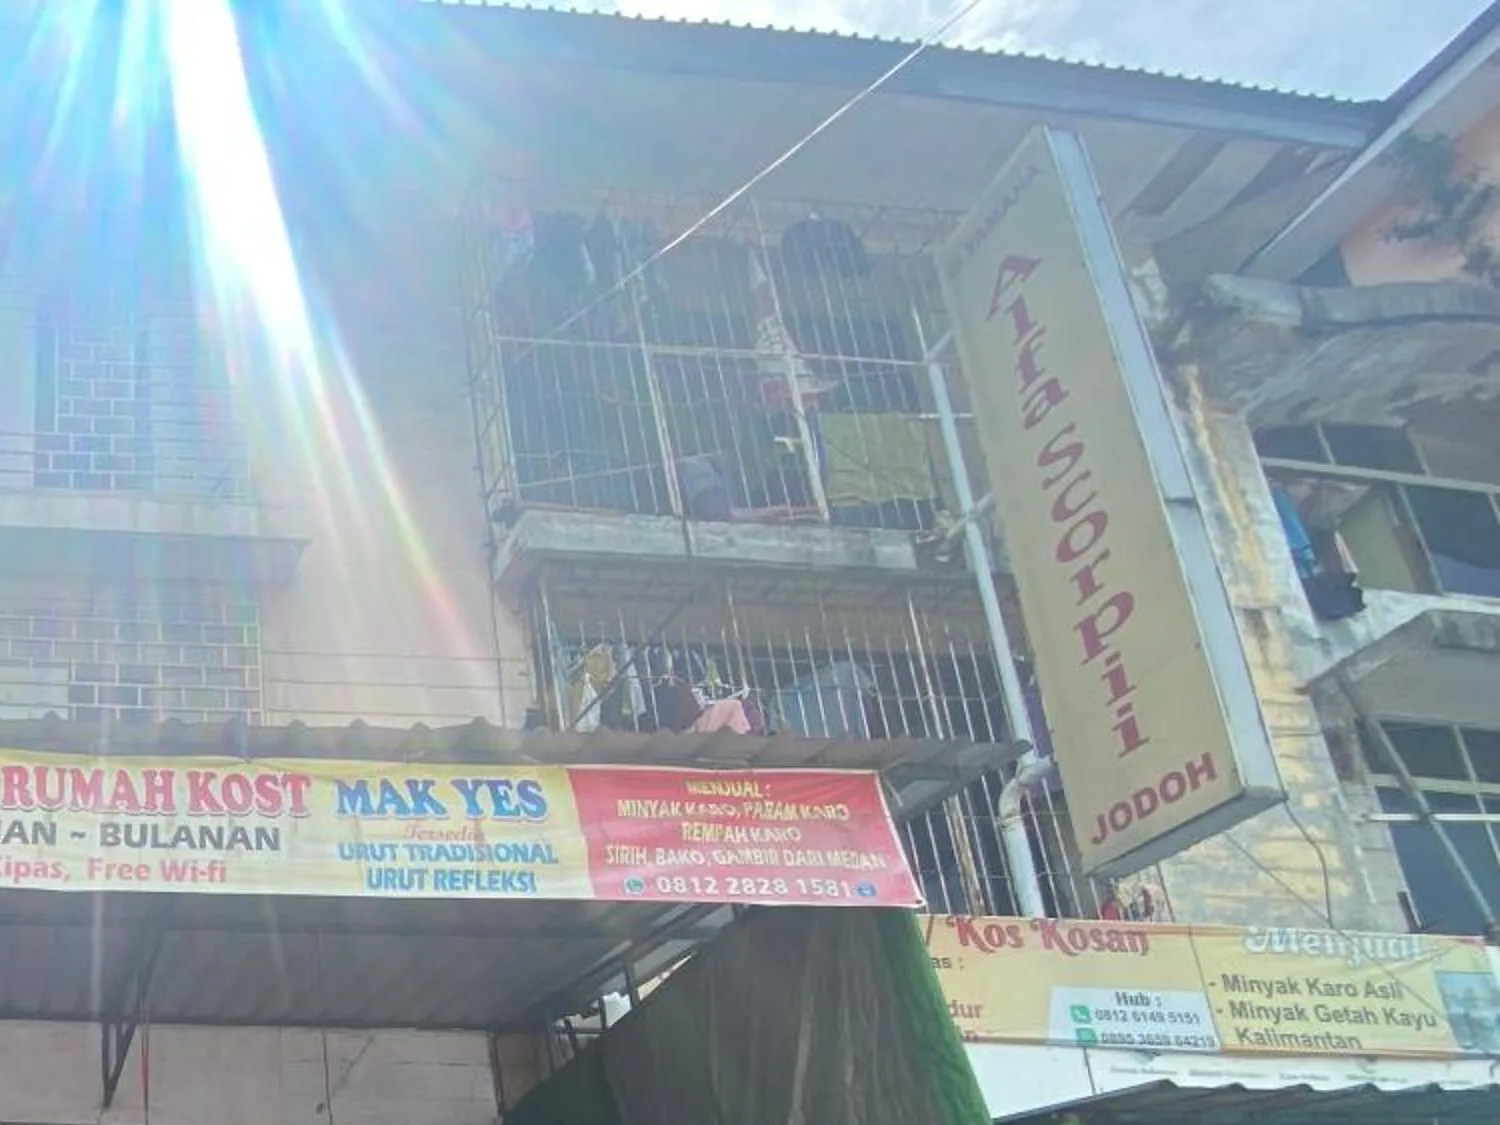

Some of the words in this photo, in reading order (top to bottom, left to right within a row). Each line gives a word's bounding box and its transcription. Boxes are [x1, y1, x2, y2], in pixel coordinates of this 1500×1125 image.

[985, 254, 1070, 431] Alfa
[1035, 423, 1152, 760] Scorpii
[0, 764, 177, 815] RUMAH
[186, 770, 312, 818] KOST
[335, 779, 448, 817] MAK
[451, 779, 549, 819] YES
[1090, 751, 1218, 846] JODOH
[618, 799, 683, 818] MINYAK
[99, 824, 281, 851] BULANAN
[337, 842, 398, 861] URUT
[405, 843, 559, 864] TRADISIONAL
[86, 860, 151, 881] Free
[159, 861, 227, 883] Wi-fi
[367, 867, 428, 890] URUT
[433, 869, 537, 893] REFLEKSI
[656, 876, 720, 895] 0812
[726, 878, 789, 896] 2828
[795, 879, 853, 898] 1581
[946, 916, 1024, 953] Kos
[1114, 991, 1151, 1007] Hub
[1221, 973, 1301, 998] Minyak
[1307, 977, 1358, 997] Karo
[1364, 979, 1401, 1000] Asli
[1228, 1000, 1310, 1025] Minyak
[1314, 1005, 1379, 1025] Getah
[1385, 1007, 1438, 1030] Kayu
[1236, 1027, 1362, 1049] Kalimantan
